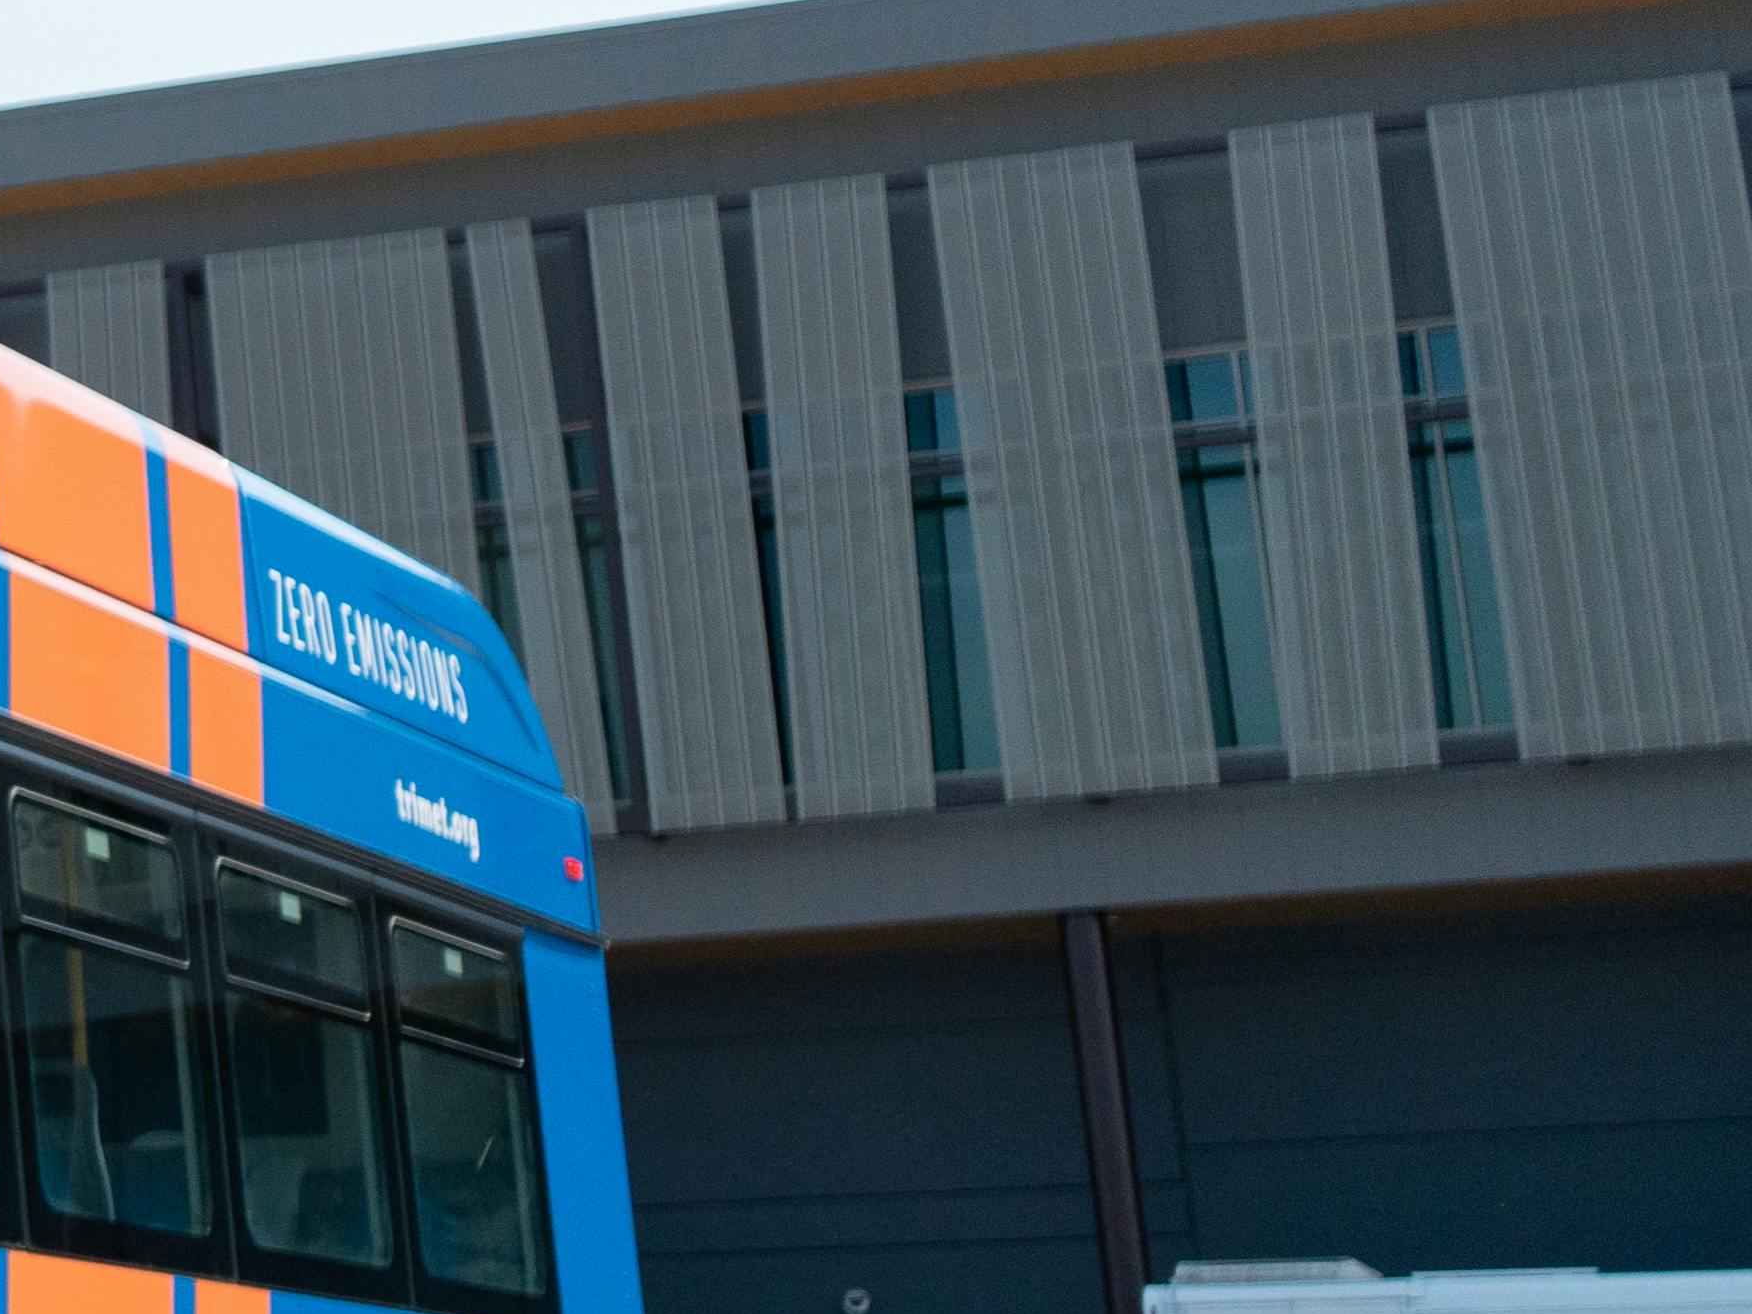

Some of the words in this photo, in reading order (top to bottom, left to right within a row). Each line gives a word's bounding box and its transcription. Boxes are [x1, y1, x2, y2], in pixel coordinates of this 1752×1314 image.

[268, 568, 337, 666] ZERO
[340, 602, 468, 724] EMISSIONS
[395, 779, 480, 863] trimet.org
